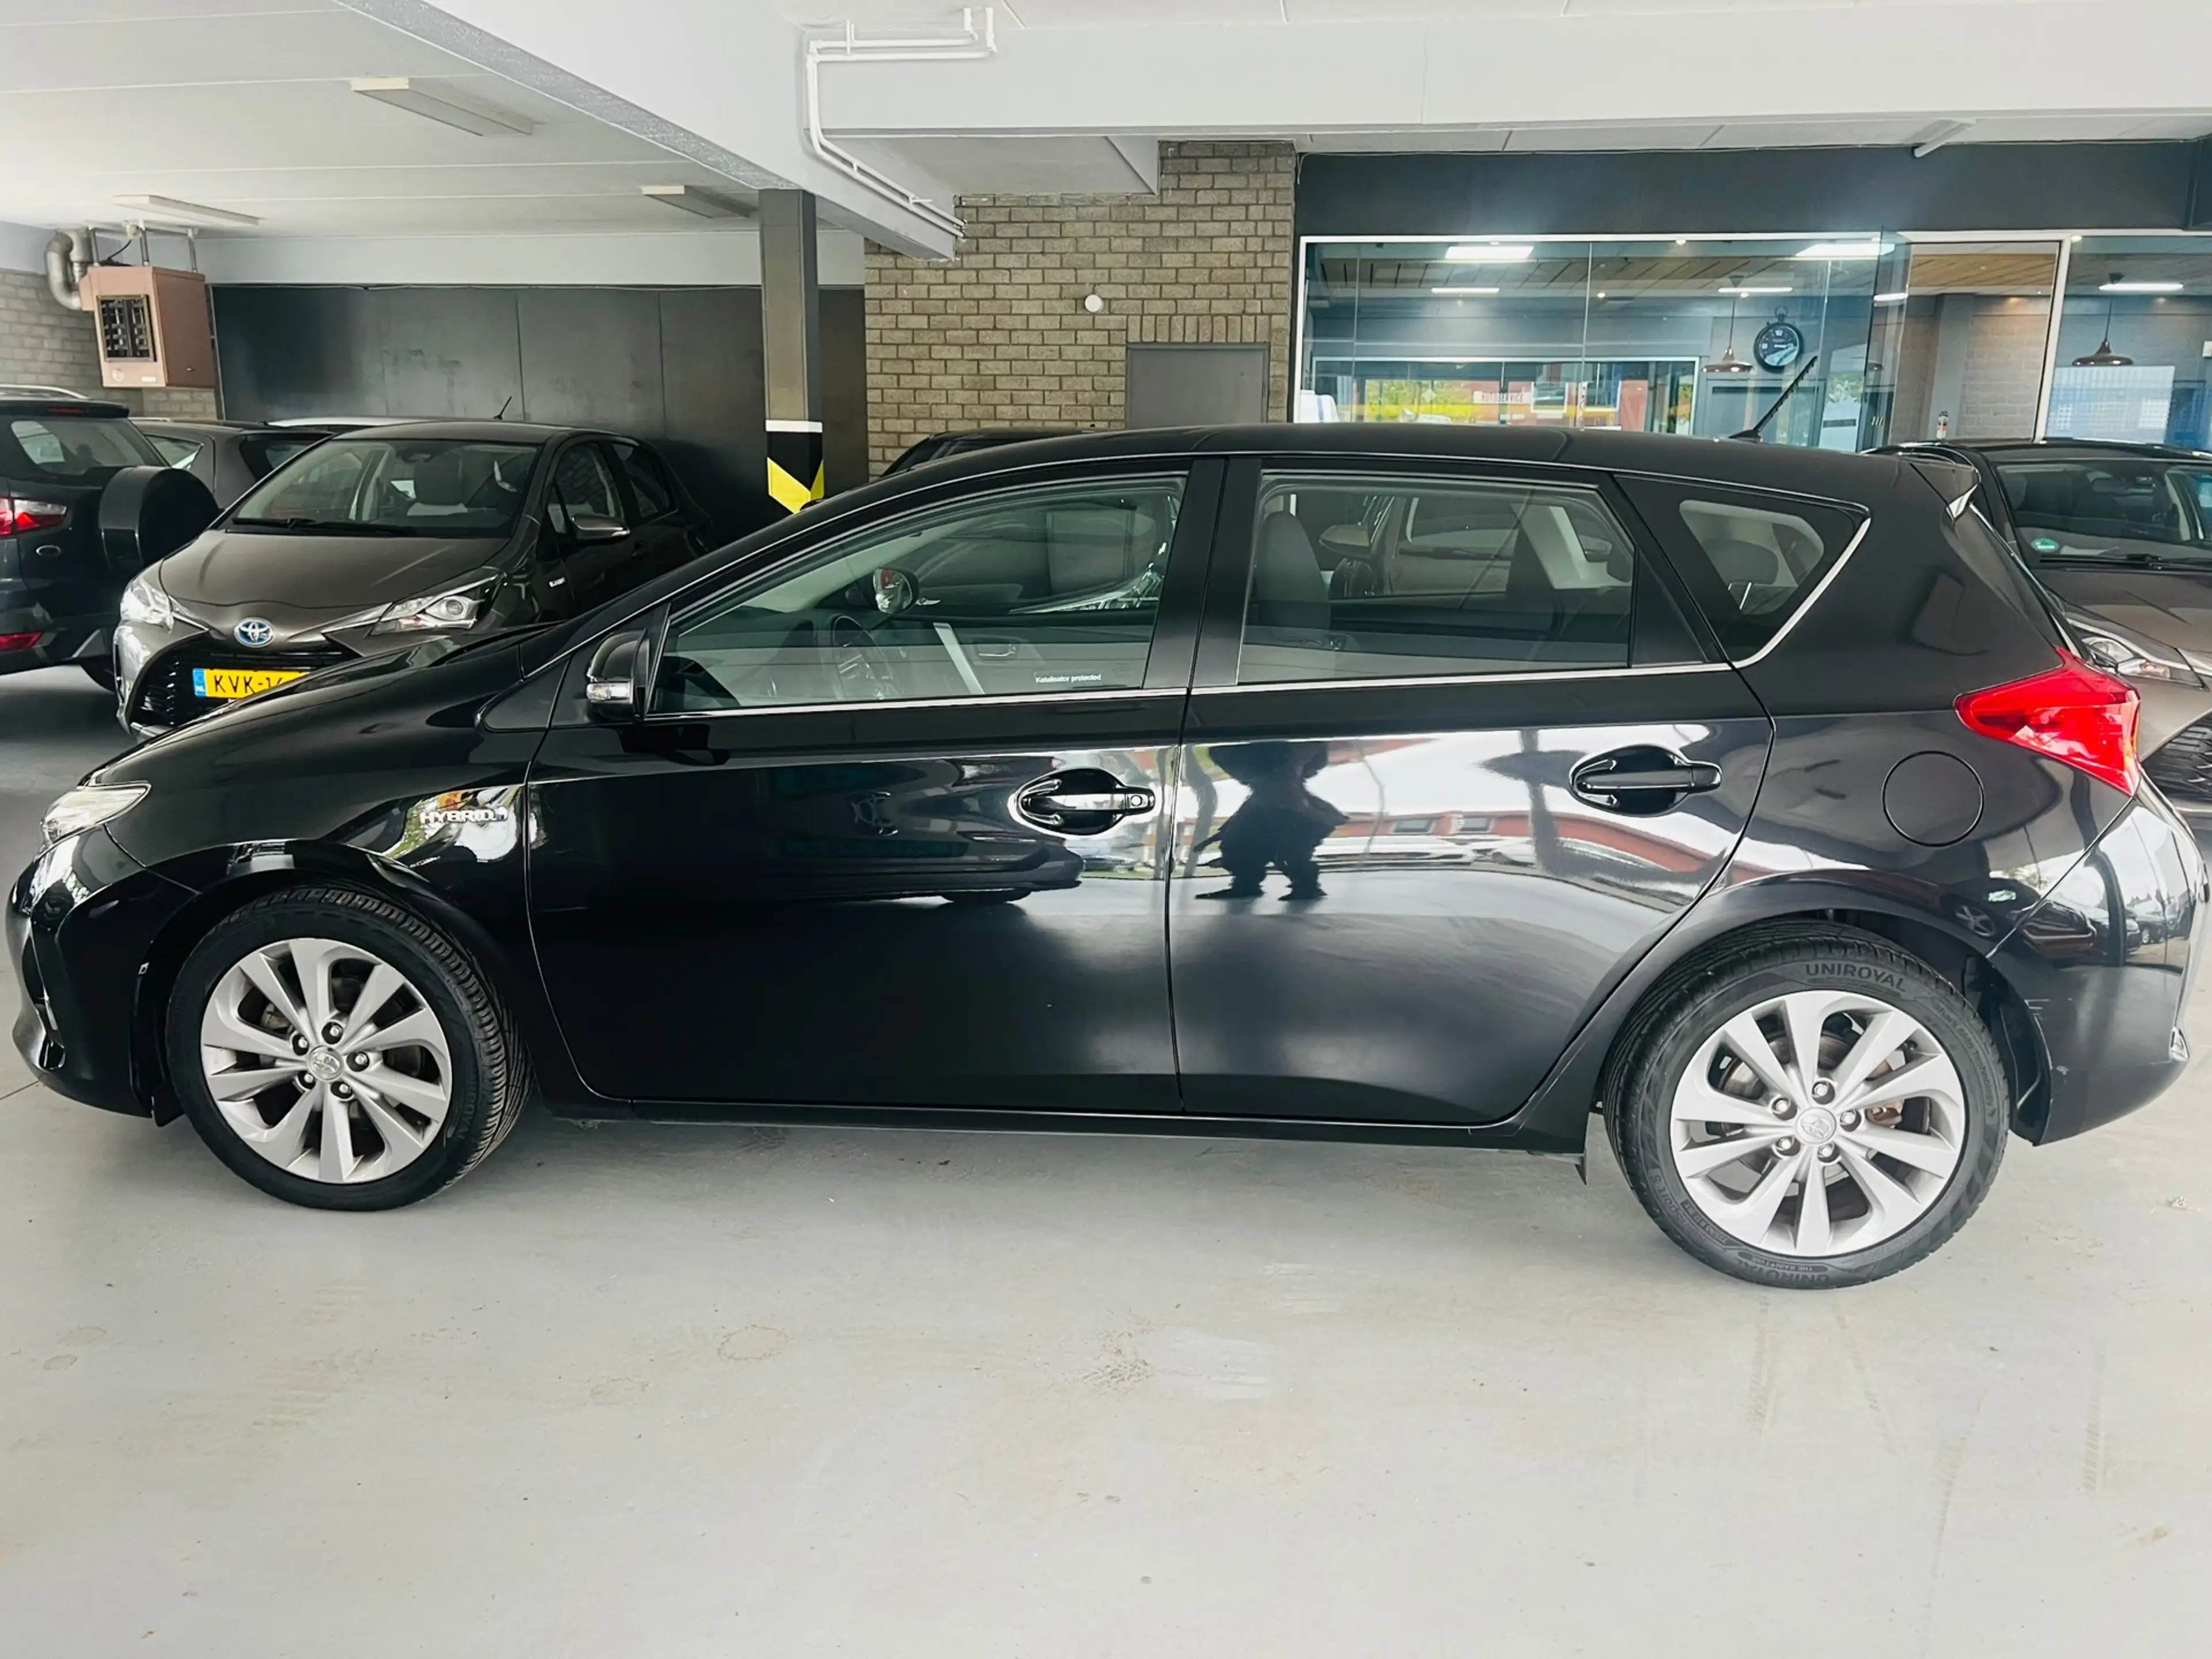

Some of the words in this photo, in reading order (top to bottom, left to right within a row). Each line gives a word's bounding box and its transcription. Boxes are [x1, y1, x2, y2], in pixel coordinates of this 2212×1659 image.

[1071, 674, 1101, 682] protected
[420, 809, 494, 823] HYBRID
[1805, 964, 1906, 991] UNIROYAL
